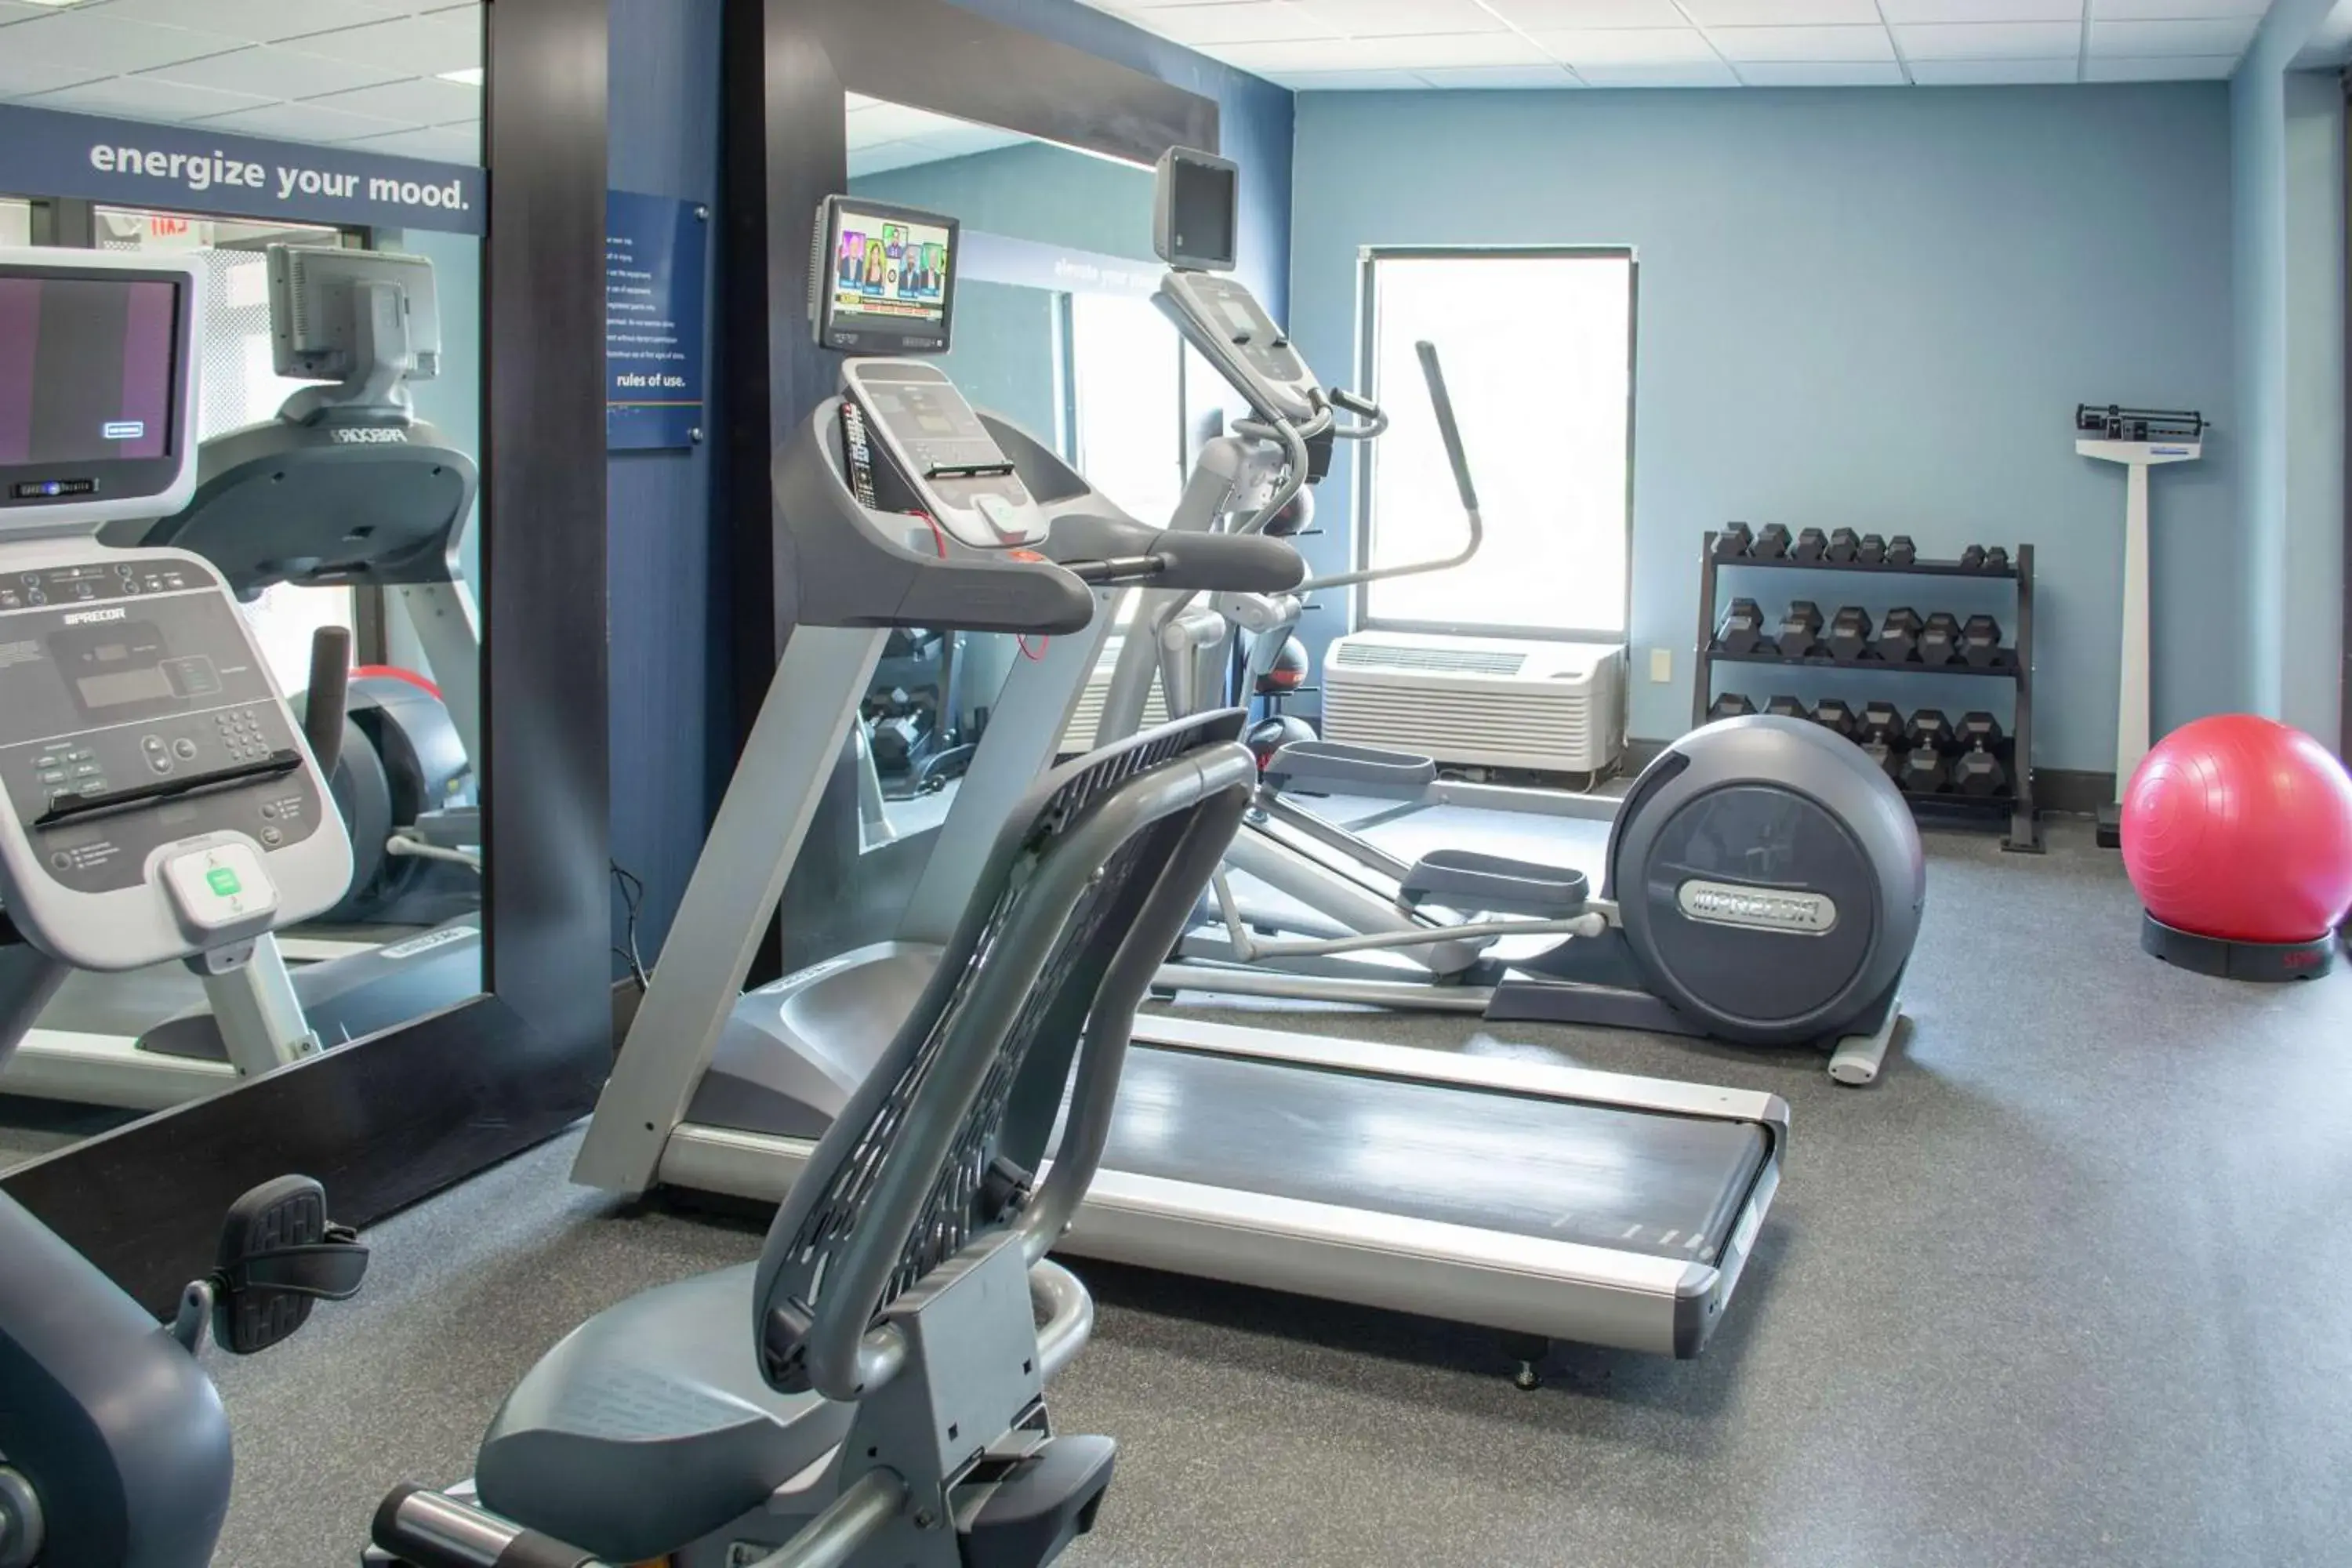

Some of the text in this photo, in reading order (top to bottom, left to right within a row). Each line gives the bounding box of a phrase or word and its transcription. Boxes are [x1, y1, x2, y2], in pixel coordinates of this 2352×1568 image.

[89, 143, 470, 210] energize your mood.
[616, 372, 687, 387] rules of use.
[75, 607, 126, 625] PRECOR
